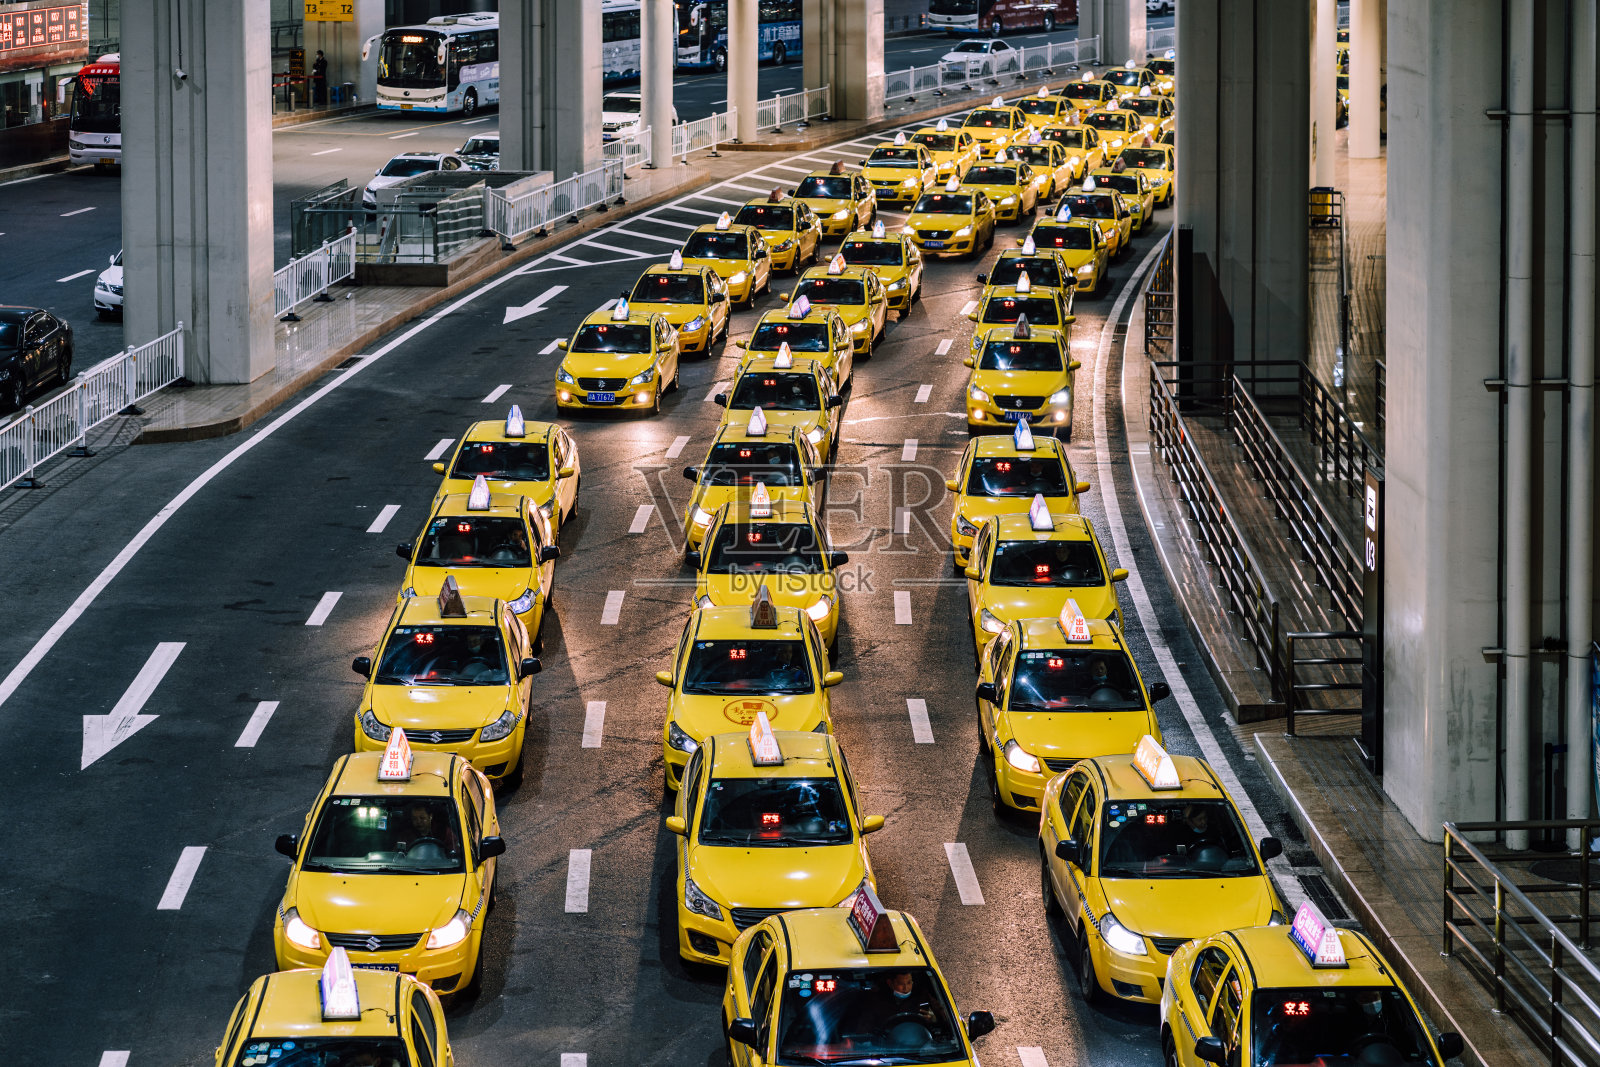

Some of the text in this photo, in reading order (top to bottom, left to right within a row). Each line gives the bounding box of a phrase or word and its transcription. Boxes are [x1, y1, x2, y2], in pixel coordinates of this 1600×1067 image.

[306, 4, 317, 13] T3
[341, 5, 352, 13] T2
[1075, 617, 1084, 634] 出租
[389, 750, 399, 769] 出租
[1325, 932, 1336, 954] 出租
[1284, 1000, 1310, 1016] 空车
